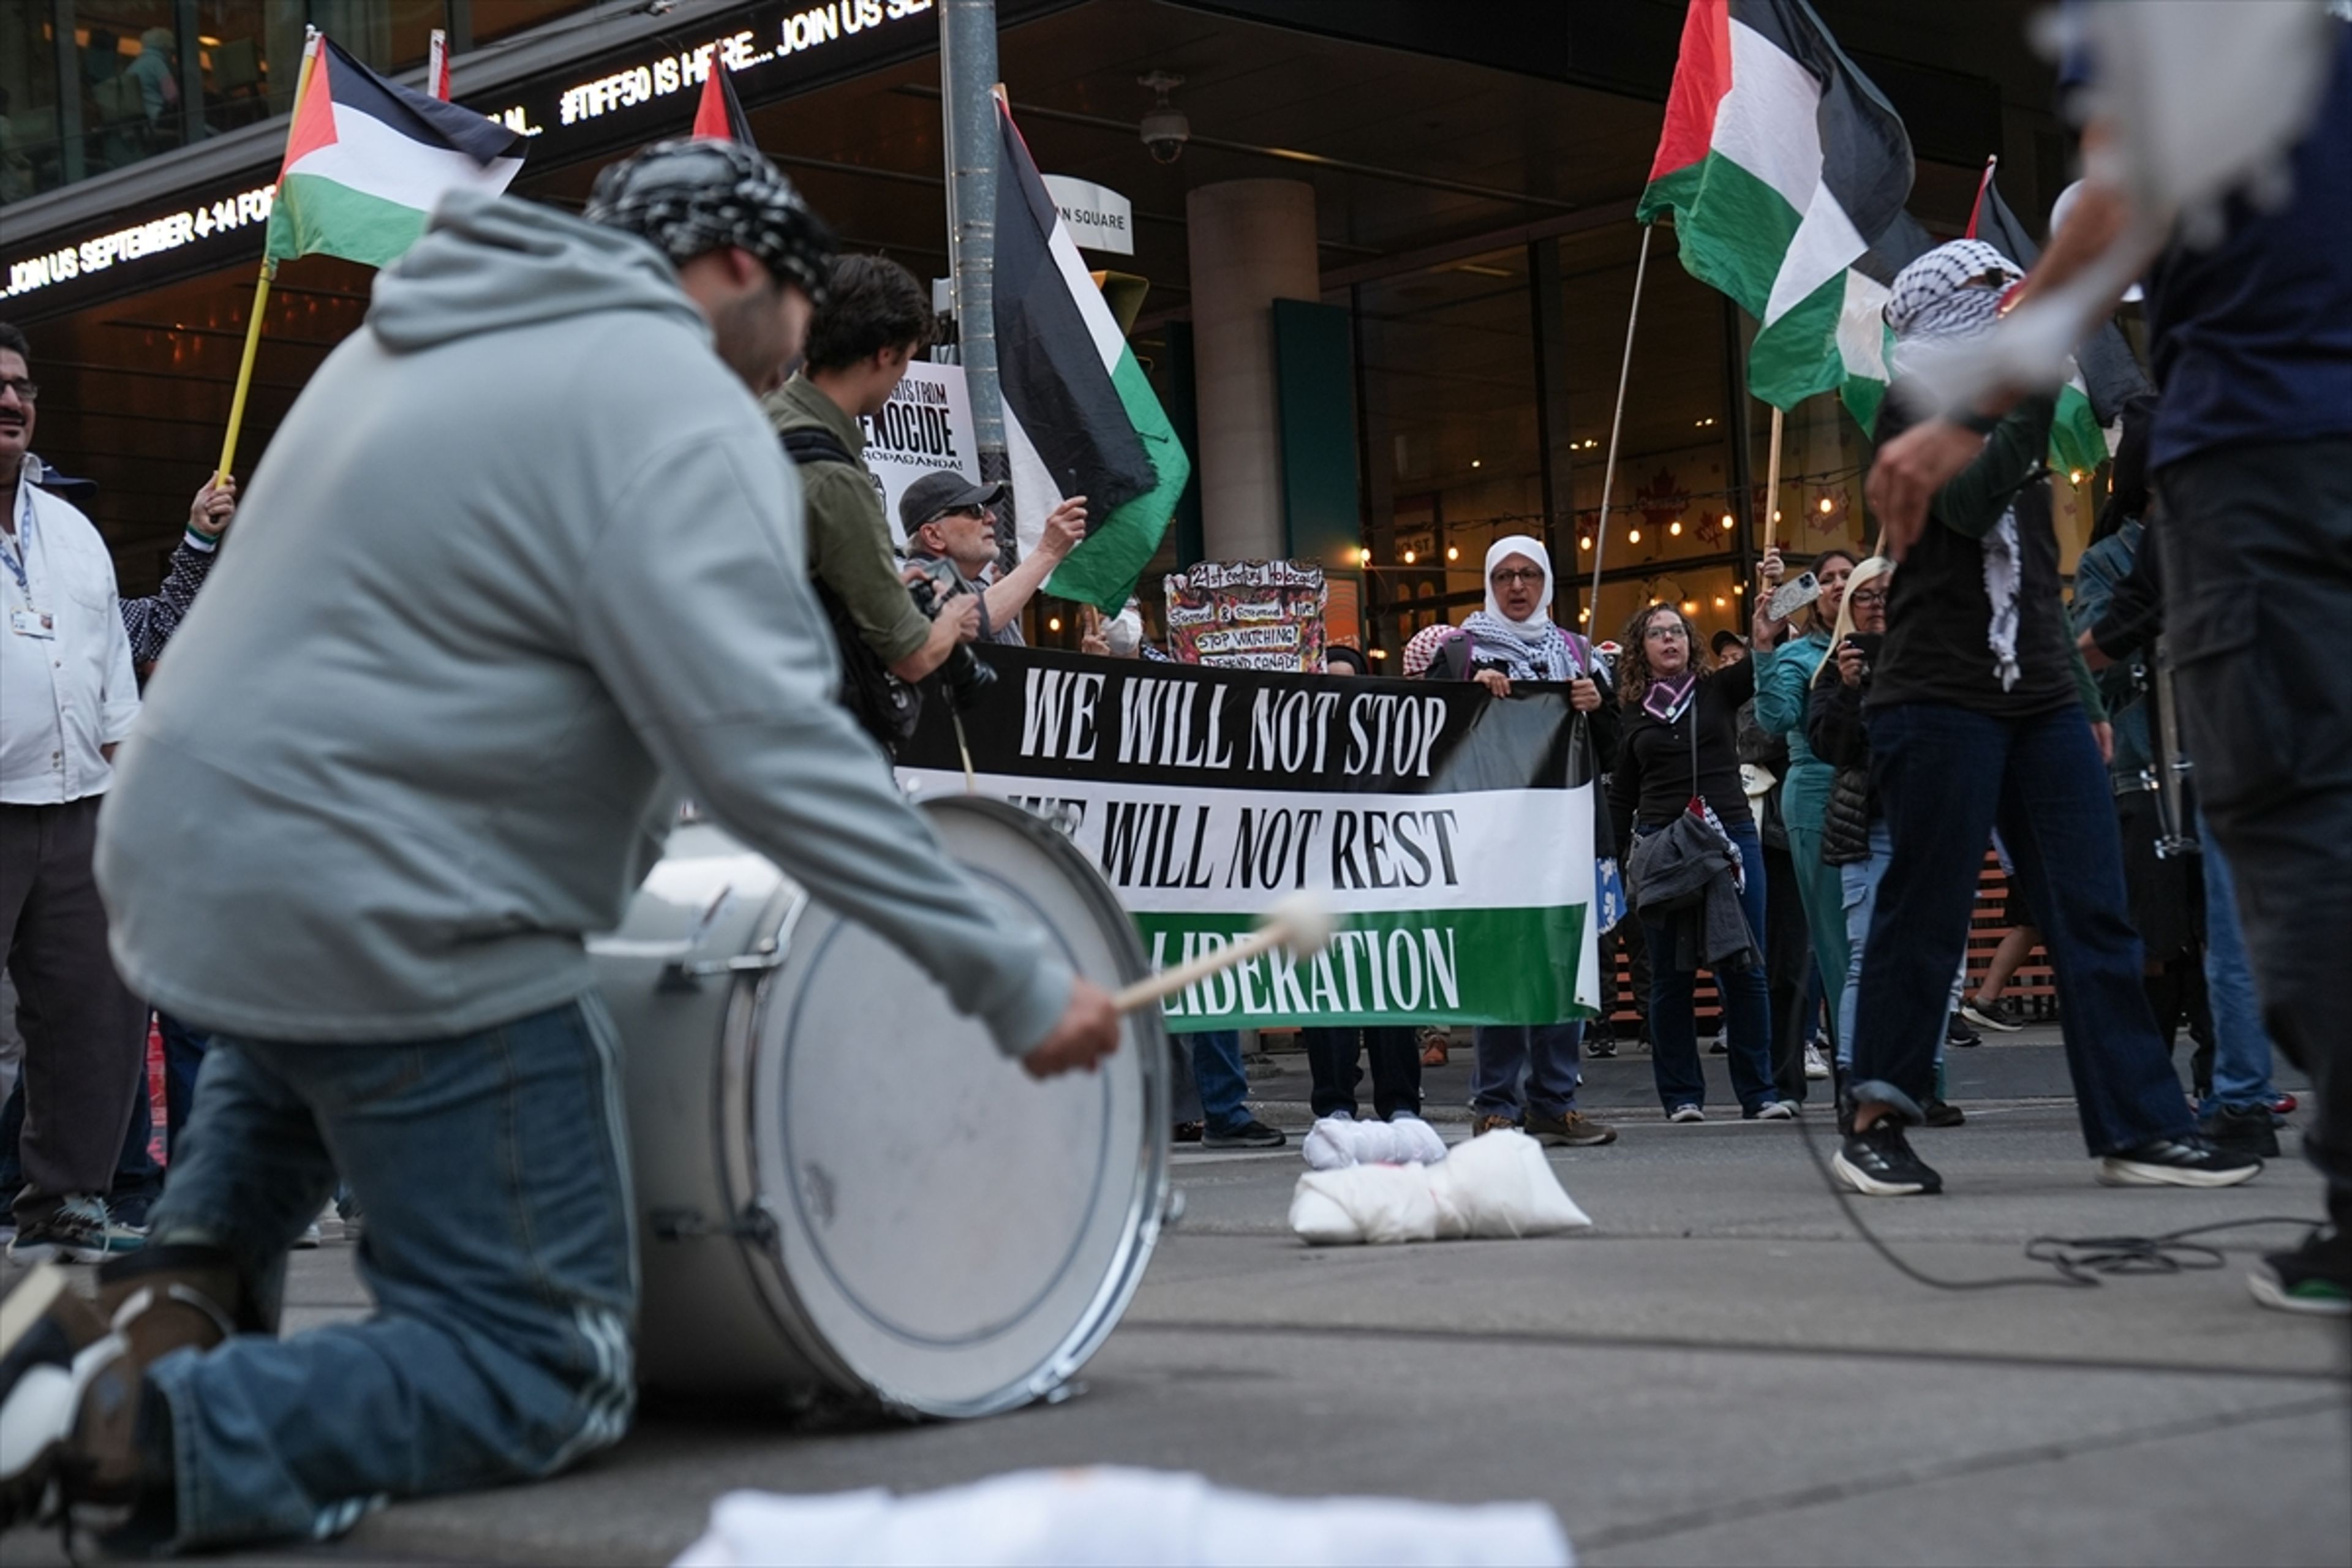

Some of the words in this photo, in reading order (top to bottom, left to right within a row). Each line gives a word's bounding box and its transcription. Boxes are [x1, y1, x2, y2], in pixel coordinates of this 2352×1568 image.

[560, 66, 652, 125] #TIFF50
[653, 57, 680, 95] IS
[776, 2, 839, 56] JOIN
[840, 0, 883, 34] US
[7, 255, 51, 296] JOIN
[48, 247, 79, 282] US
[79, 211, 195, 273] SEPTEMBER
[194, 197, 238, 238] 4-14
[1074, 209, 1125, 230] SQUARE
[1197, 633, 1230, 650] STOP
[1020, 668, 1106, 761] WE
[1118, 677, 1233, 769] WILL
[1246, 687, 1341, 773] NOT
[1344, 693, 1447, 777] STOP
[1102, 801, 1214, 888] WILL
[1225, 808, 1322, 890] NOT
[1331, 809, 1459, 889] REST
